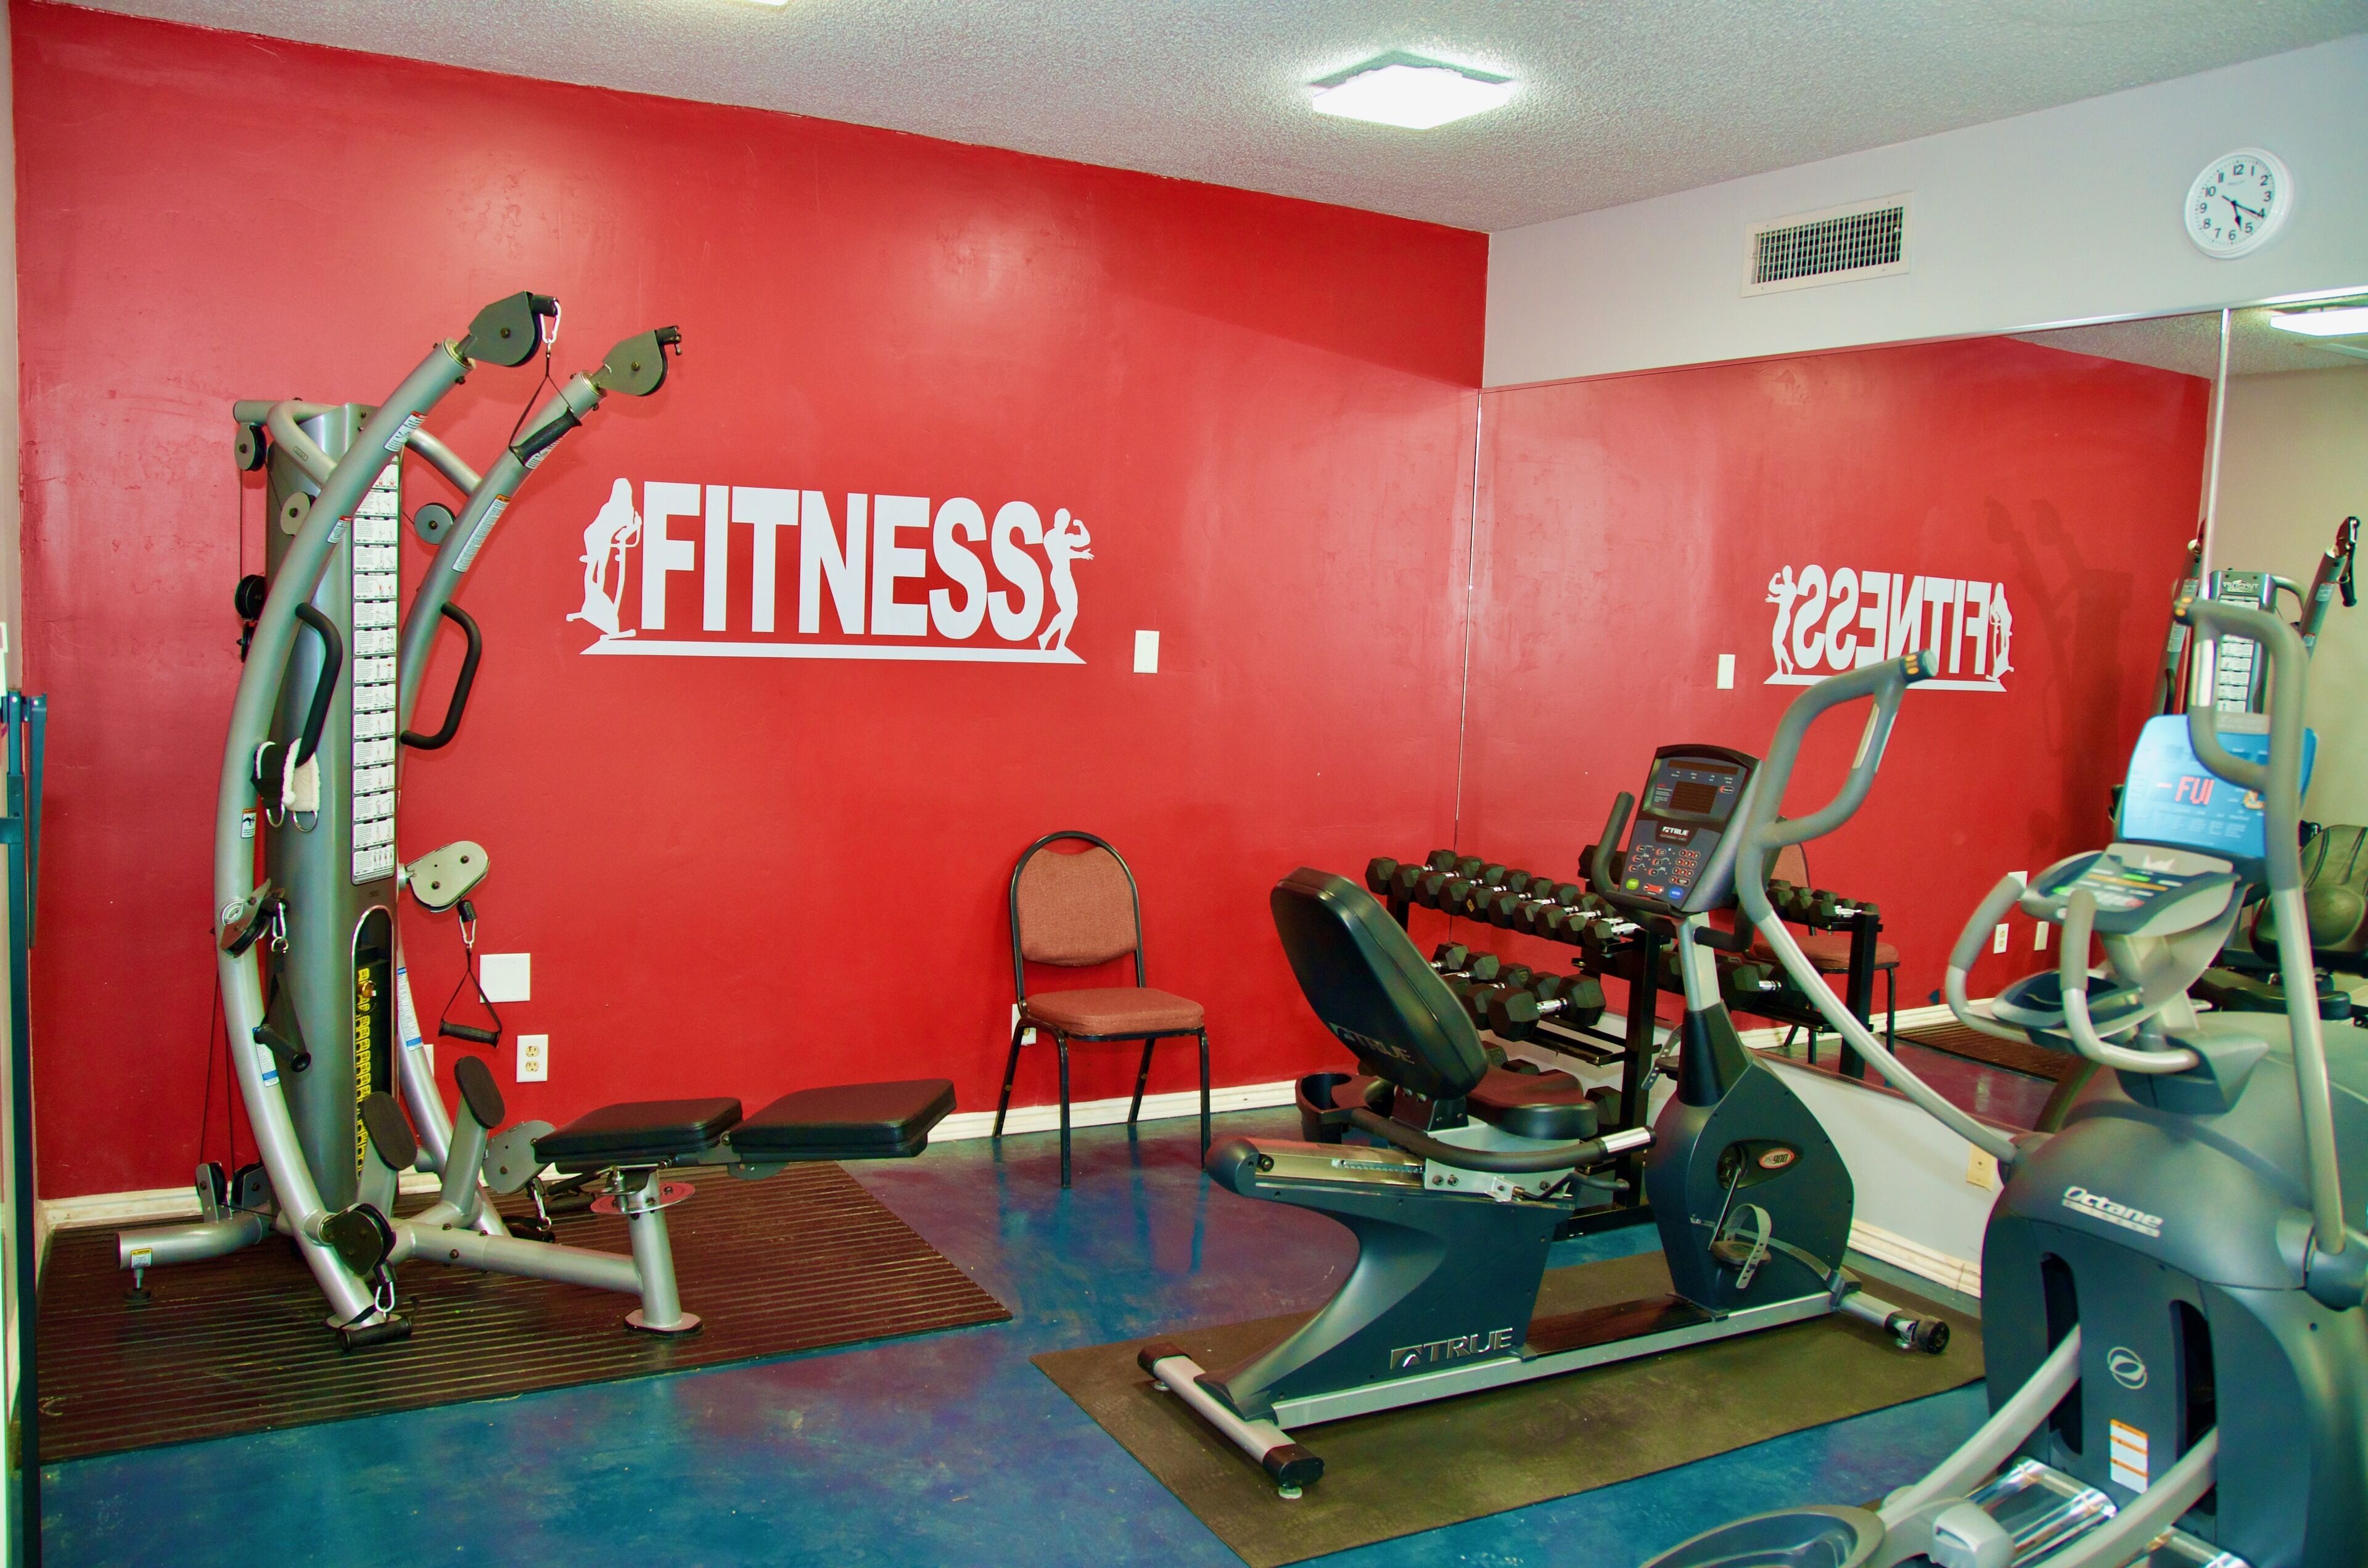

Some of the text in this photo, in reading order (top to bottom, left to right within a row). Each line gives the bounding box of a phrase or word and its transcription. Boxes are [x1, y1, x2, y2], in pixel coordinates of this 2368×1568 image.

[2232, 163, 2244, 176] 12
[2250, 165, 2255, 176] 1
[2218, 172, 2224, 184] 11
[2259, 174, 2269, 186] 2
[2205, 186, 2217, 198] 10
[2263, 190, 2272, 203] 3
[2199, 202, 2208, 214] 9
[2203, 218, 2211, 229] 8
[2245, 222, 2253, 234] 5
[2214, 227, 2222, 239] 7
[2228, 229, 2236, 241] 6
[641, 480, 1043, 641] FITNESS
[1669, 827, 1690, 836] TRUE
[2063, 1185, 2164, 1228] Octane
[1423, 1327, 1513, 1363] TRUE
